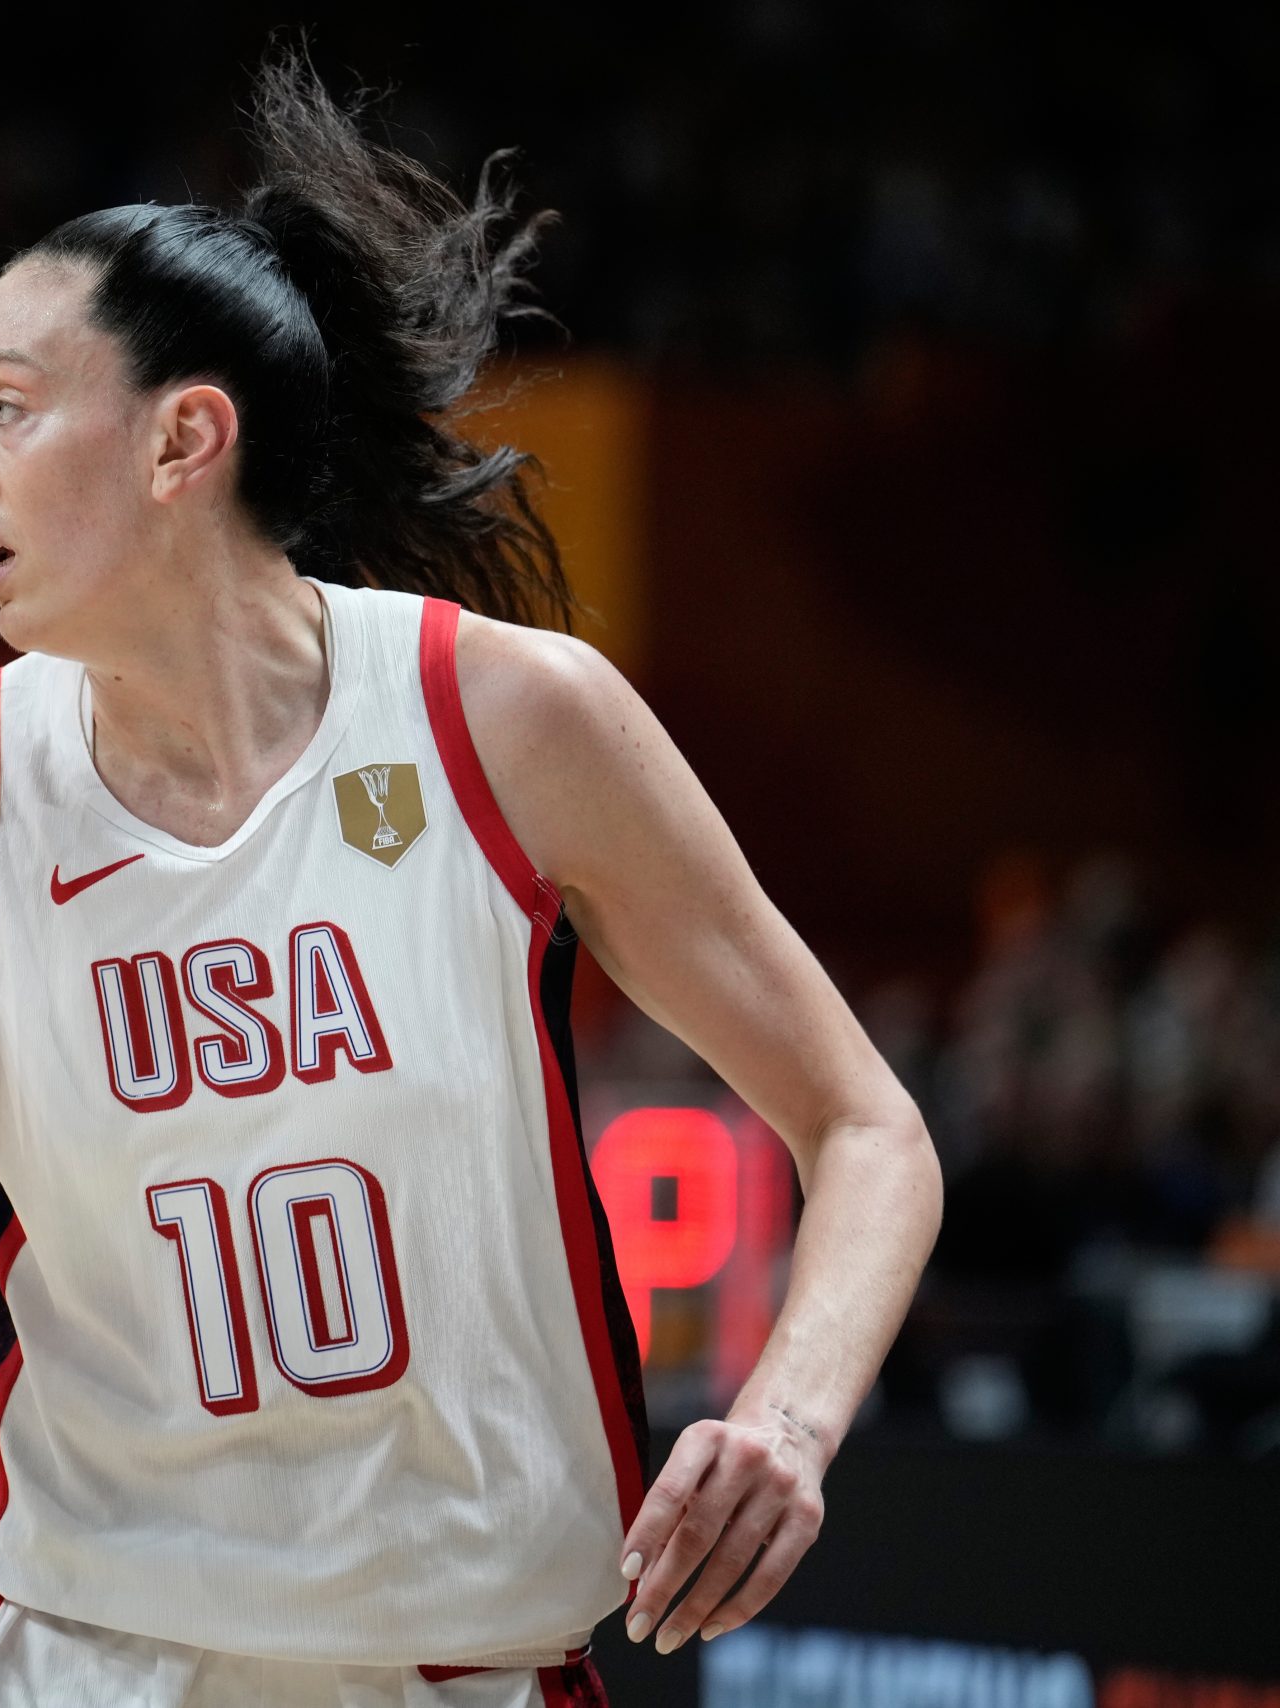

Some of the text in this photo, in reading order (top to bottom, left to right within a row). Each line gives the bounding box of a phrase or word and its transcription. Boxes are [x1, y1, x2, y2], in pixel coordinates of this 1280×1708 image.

[378, 835, 395, 846] FIBA
[91, 921, 393, 1113] USA
[145, 1158, 410, 1417] 10
